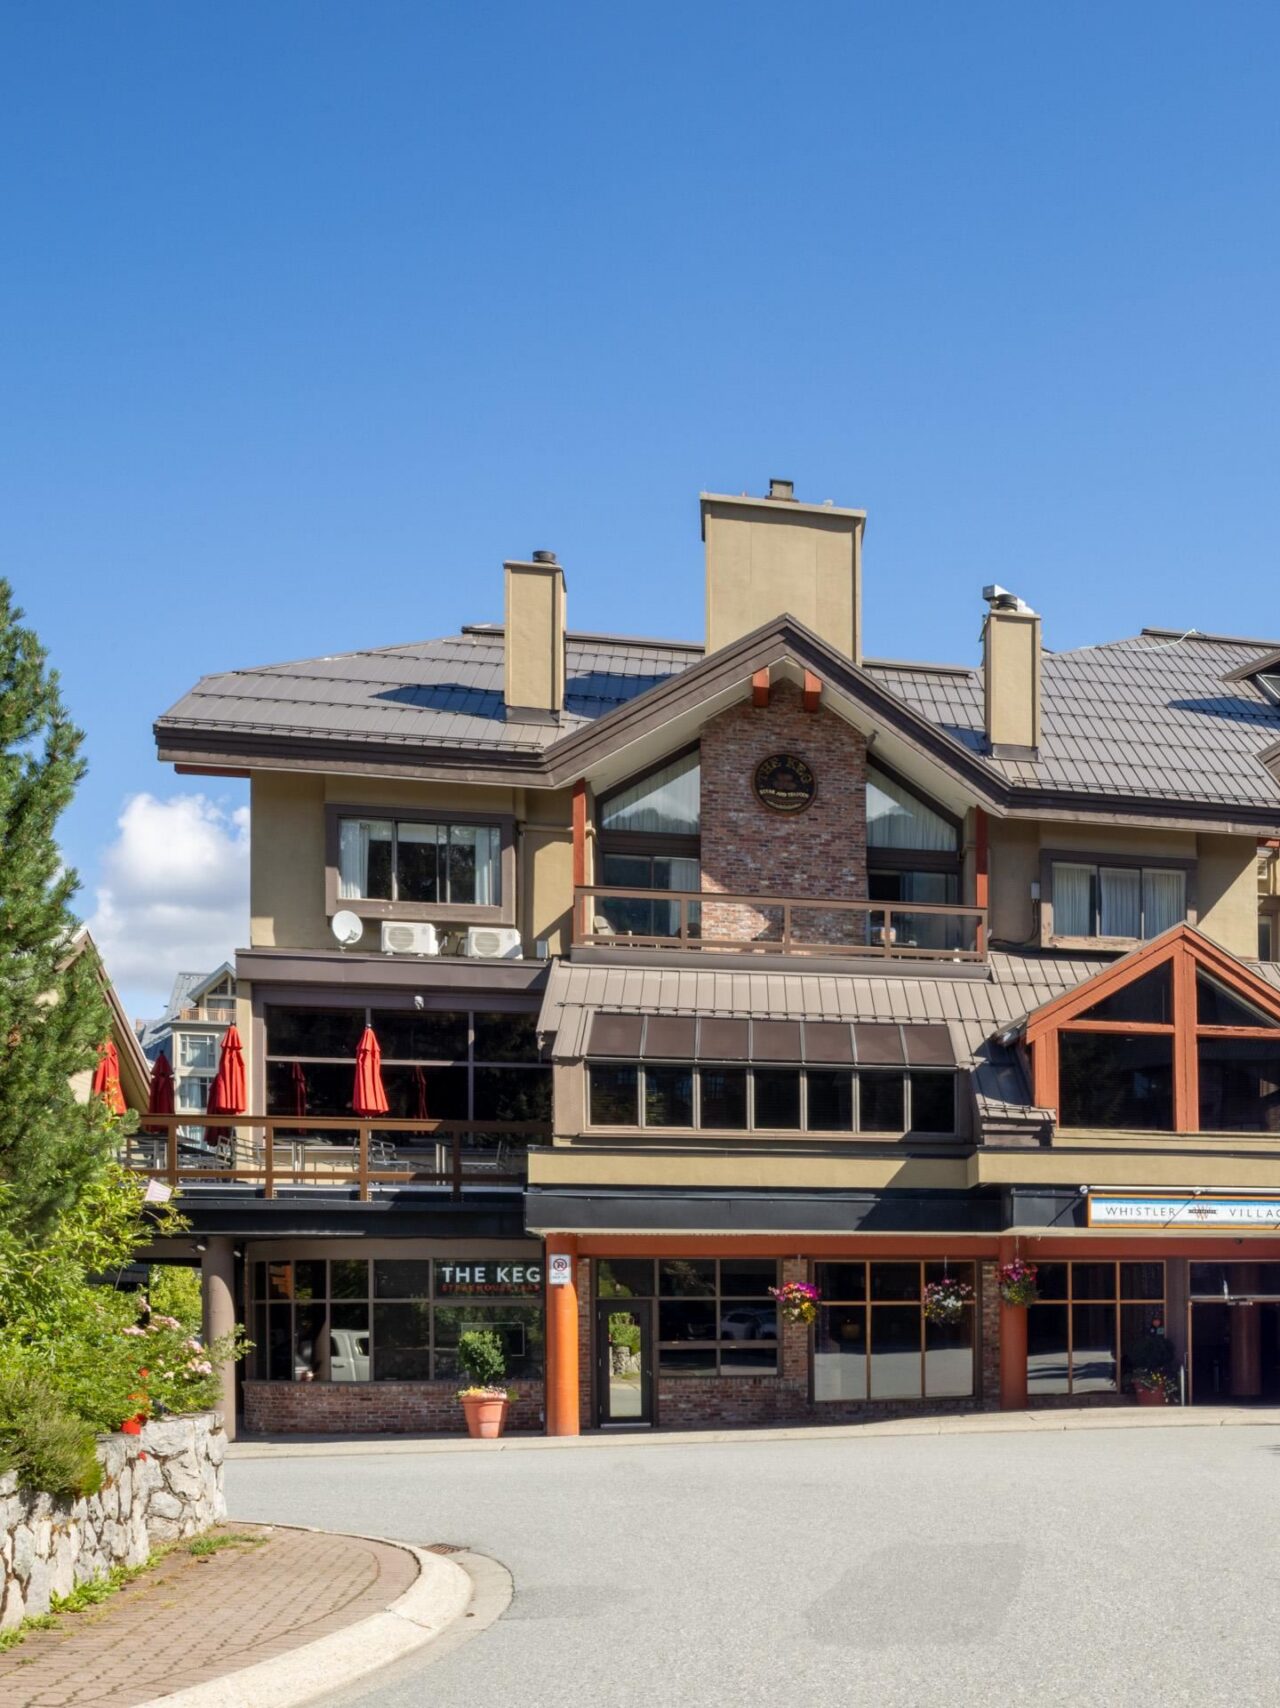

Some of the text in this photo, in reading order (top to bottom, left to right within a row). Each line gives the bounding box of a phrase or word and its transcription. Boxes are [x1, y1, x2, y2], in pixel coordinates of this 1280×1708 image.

[1105, 1206, 1176, 1217] WHISTLER
[442, 1267, 486, 1283] THE
[497, 1267, 541, 1283] KEG
